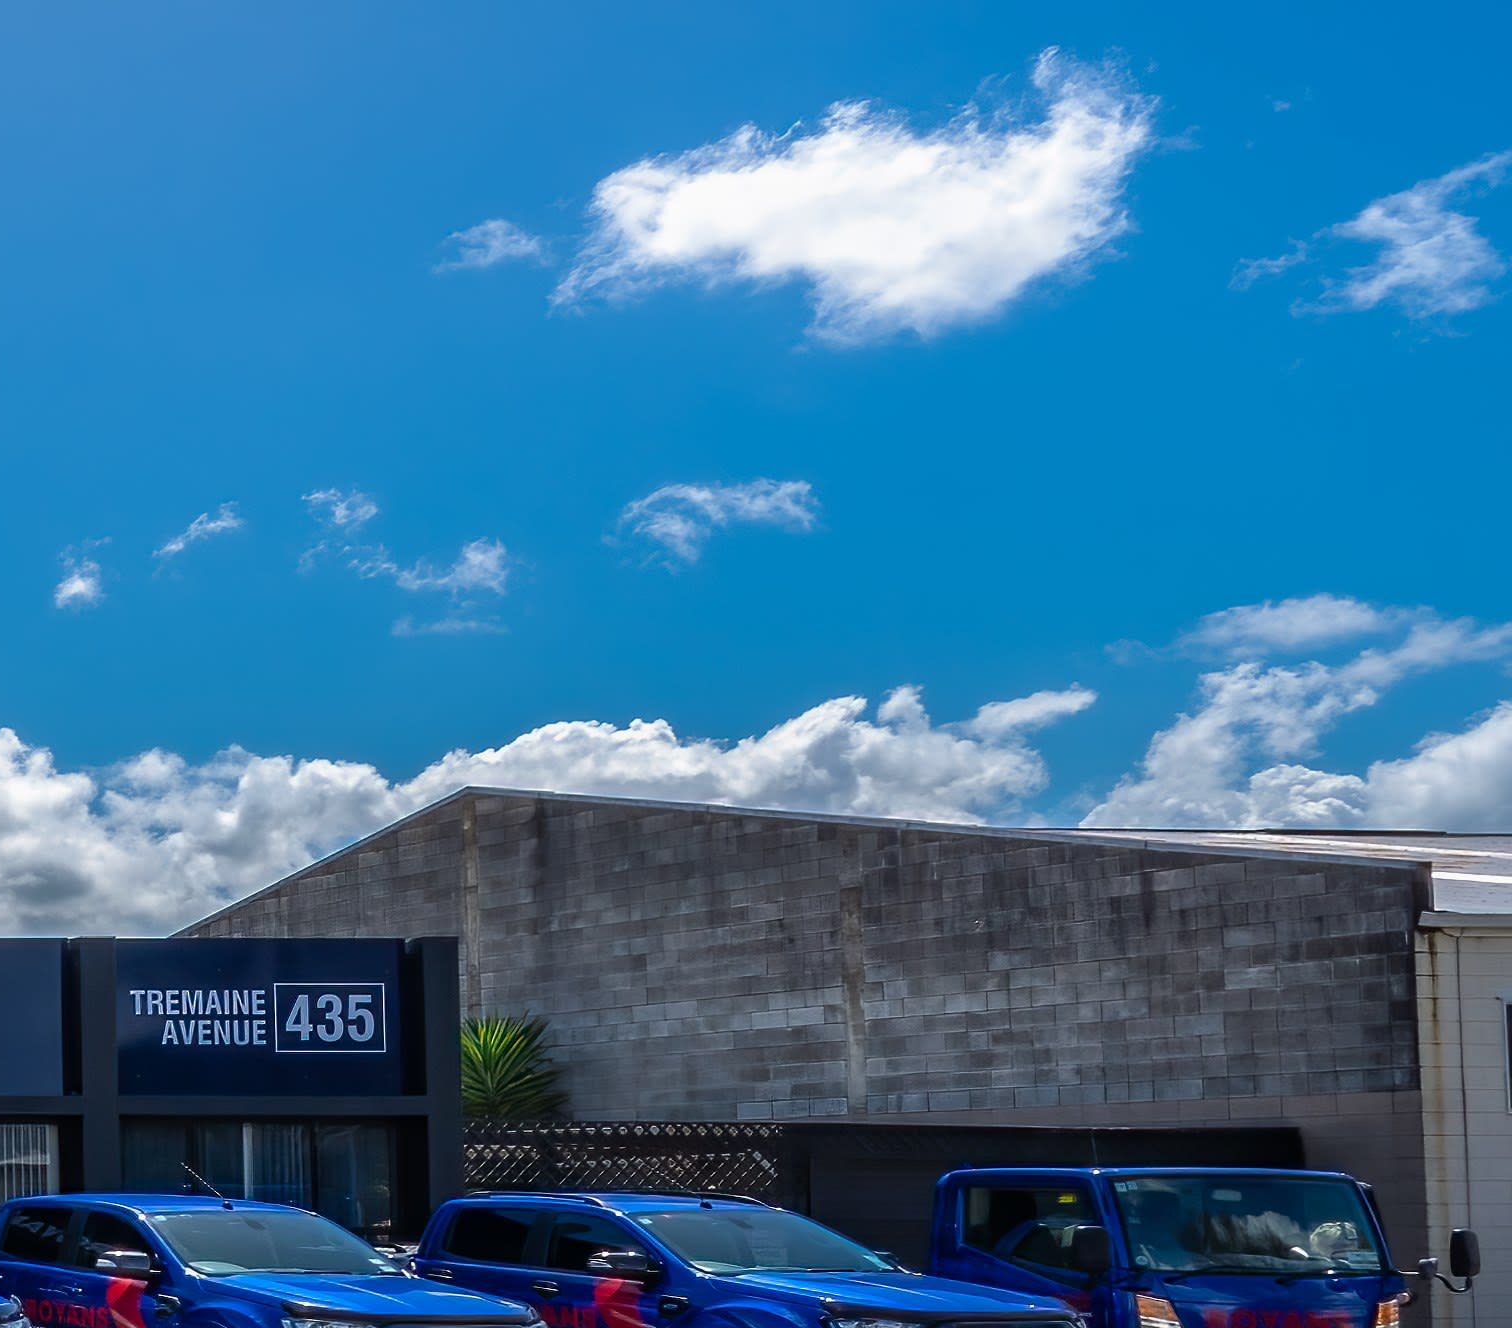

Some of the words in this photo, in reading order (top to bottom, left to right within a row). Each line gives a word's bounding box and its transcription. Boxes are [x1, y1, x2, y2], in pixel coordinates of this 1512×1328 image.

[130, 989, 266, 1016] TREMAINE
[284, 994, 375, 1043] 435
[162, 1019, 267, 1046] AVENUE
